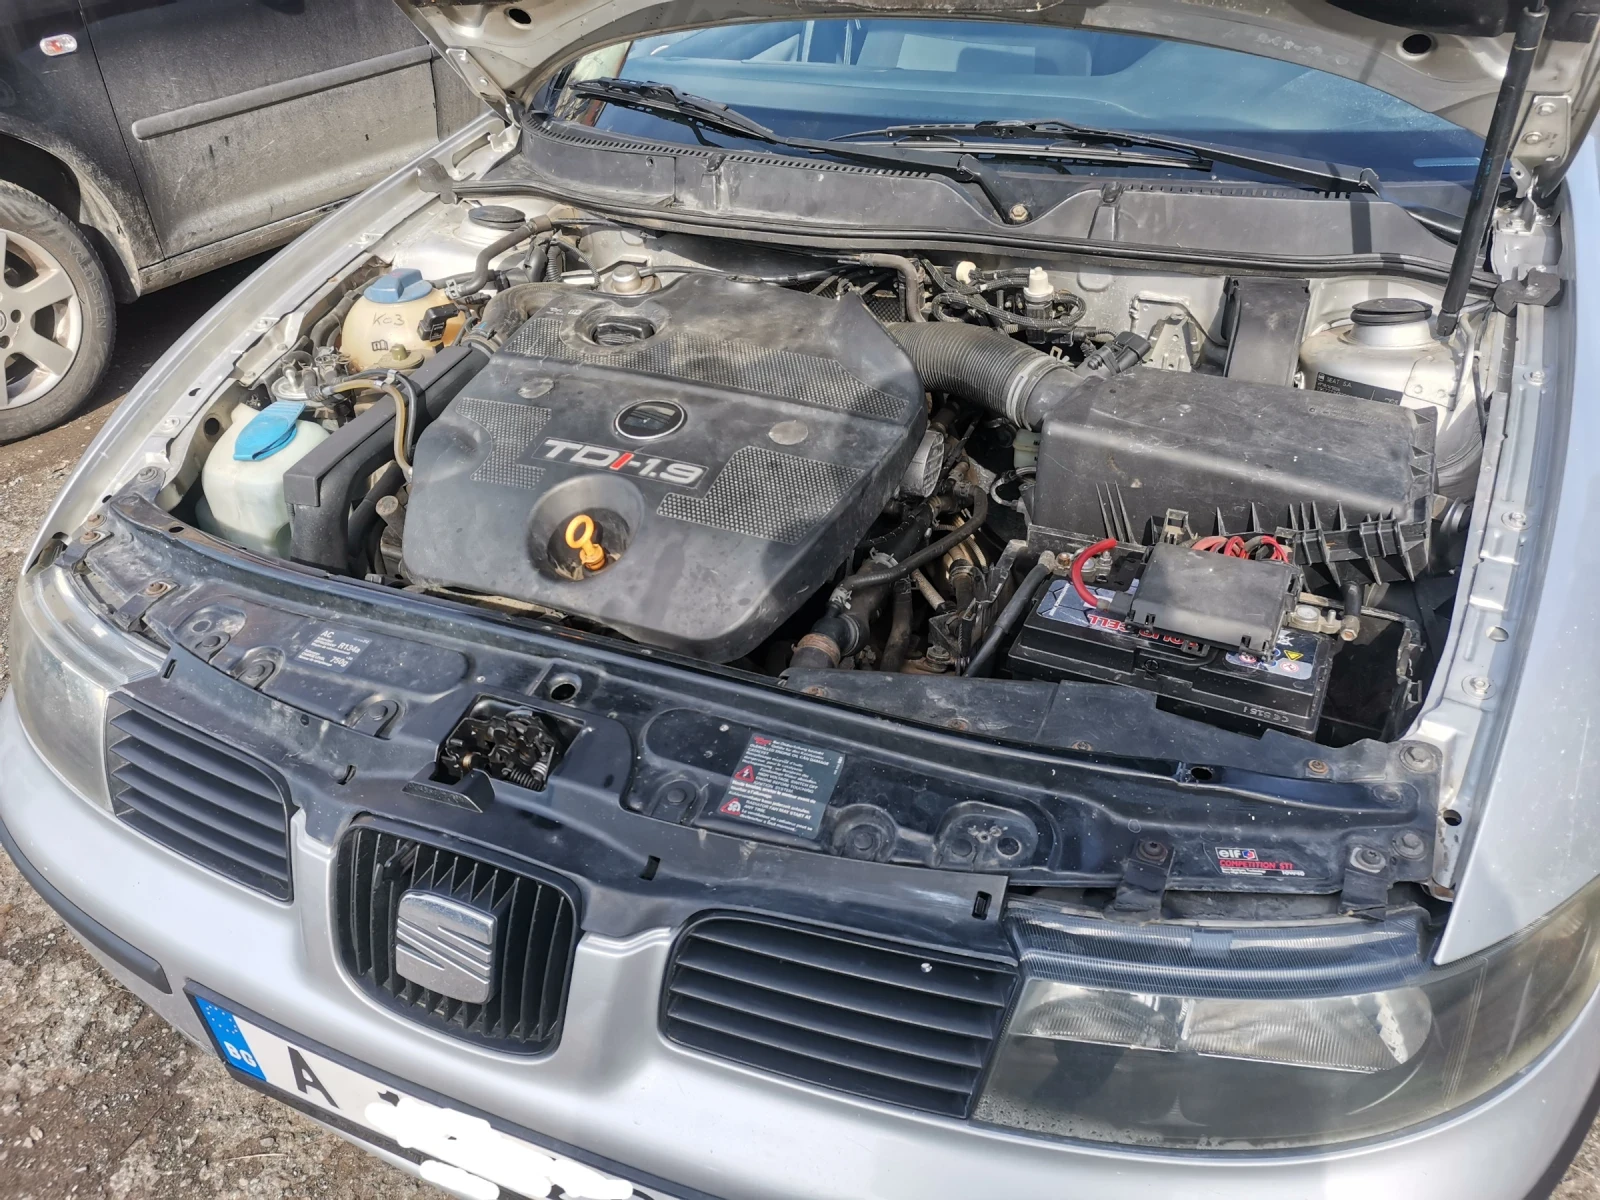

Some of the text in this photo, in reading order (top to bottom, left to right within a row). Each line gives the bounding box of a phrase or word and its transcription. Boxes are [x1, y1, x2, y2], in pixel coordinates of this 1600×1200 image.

[320, 630, 335, 638] AC
[337, 642, 361, 654] R134a
[1218, 849, 1242, 859] elf
[1220, 860, 1276, 870] COMPETITION
[223, 1041, 257, 1068] BG
